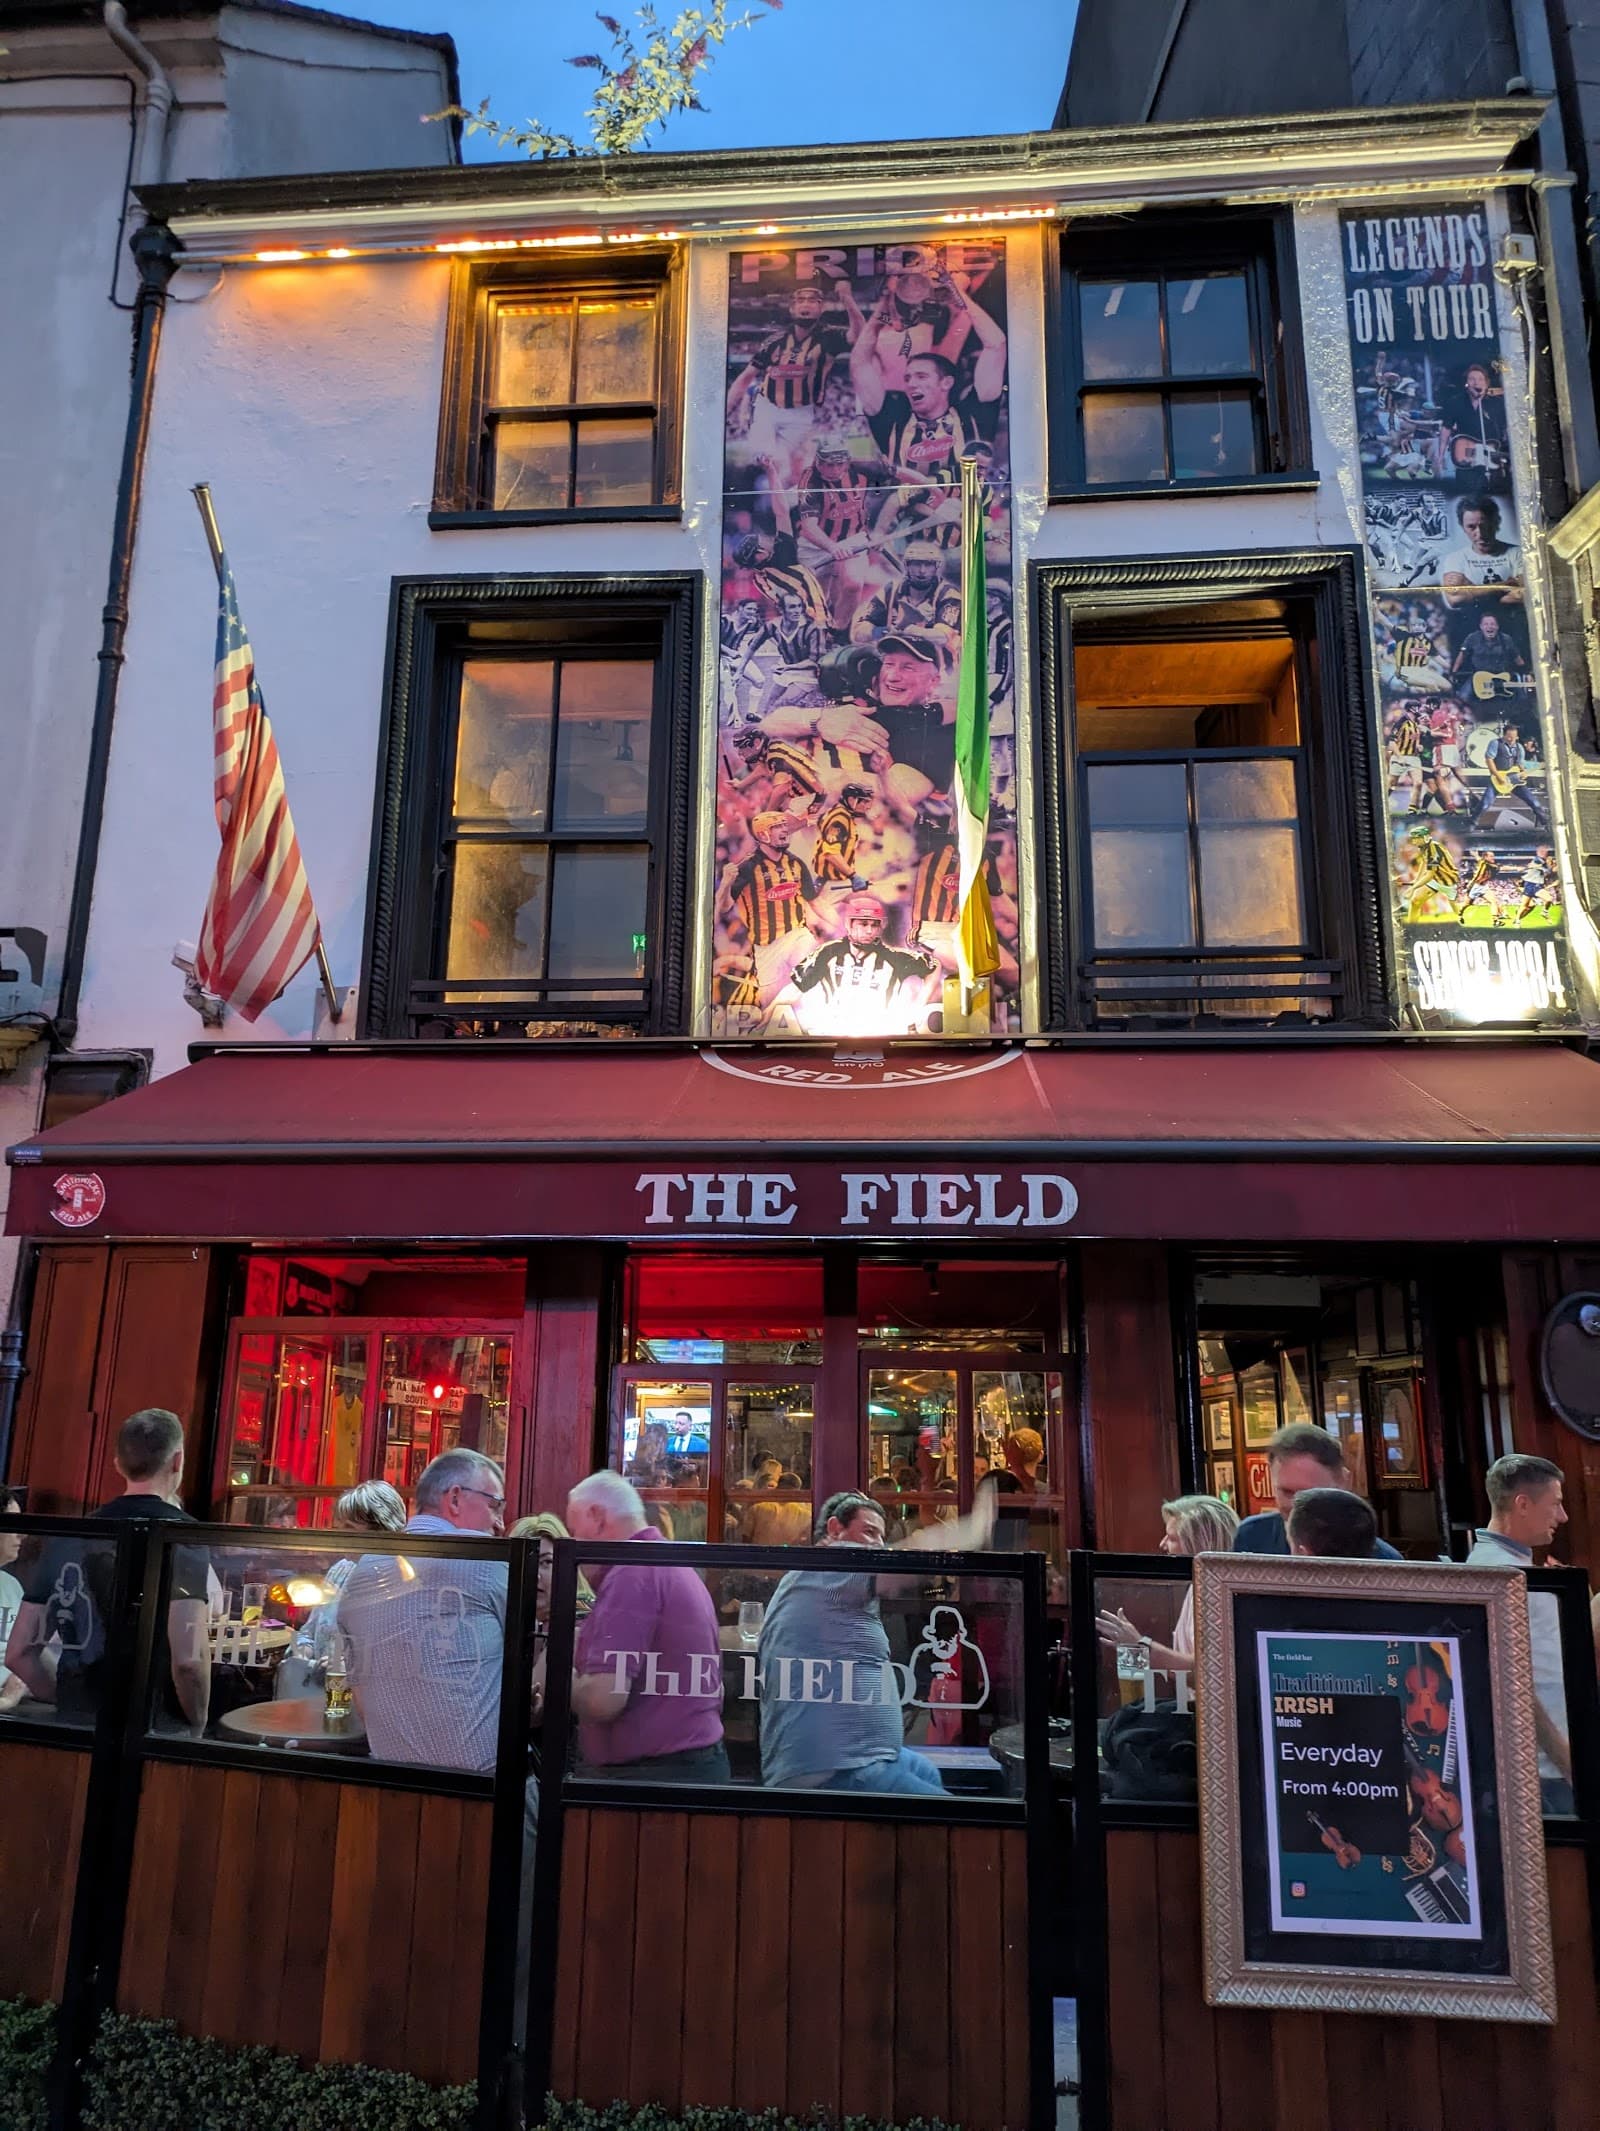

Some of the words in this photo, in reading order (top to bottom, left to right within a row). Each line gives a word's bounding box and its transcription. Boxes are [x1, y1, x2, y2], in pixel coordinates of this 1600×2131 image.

[1346, 213, 1488, 273] LEGENDS
[741, 241, 996, 284] PRIDE
[1353, 287, 1395, 344] ON
[1406, 283, 1495, 342] TOUR
[1413, 939, 1490, 1010] SINCE
[760, 1064, 853, 1083] RED
[882, 1062, 965, 1082] ALE
[635, 1173, 798, 1224] THE
[840, 1173, 1079, 1226] FIELD
[58, 1210, 75, 1222] RED
[77, 1210, 93, 1223] ALE
[1273, 1672, 1374, 1694] Traditional
[1274, 1696, 1334, 1715] IRISH
[1276, 1716, 1302, 1728] Music
[1281, 1742, 1383, 1768] Everyday
[1282, 1780, 1328, 1795] From
[1332, 1781, 1399, 1800] 4:00pm
